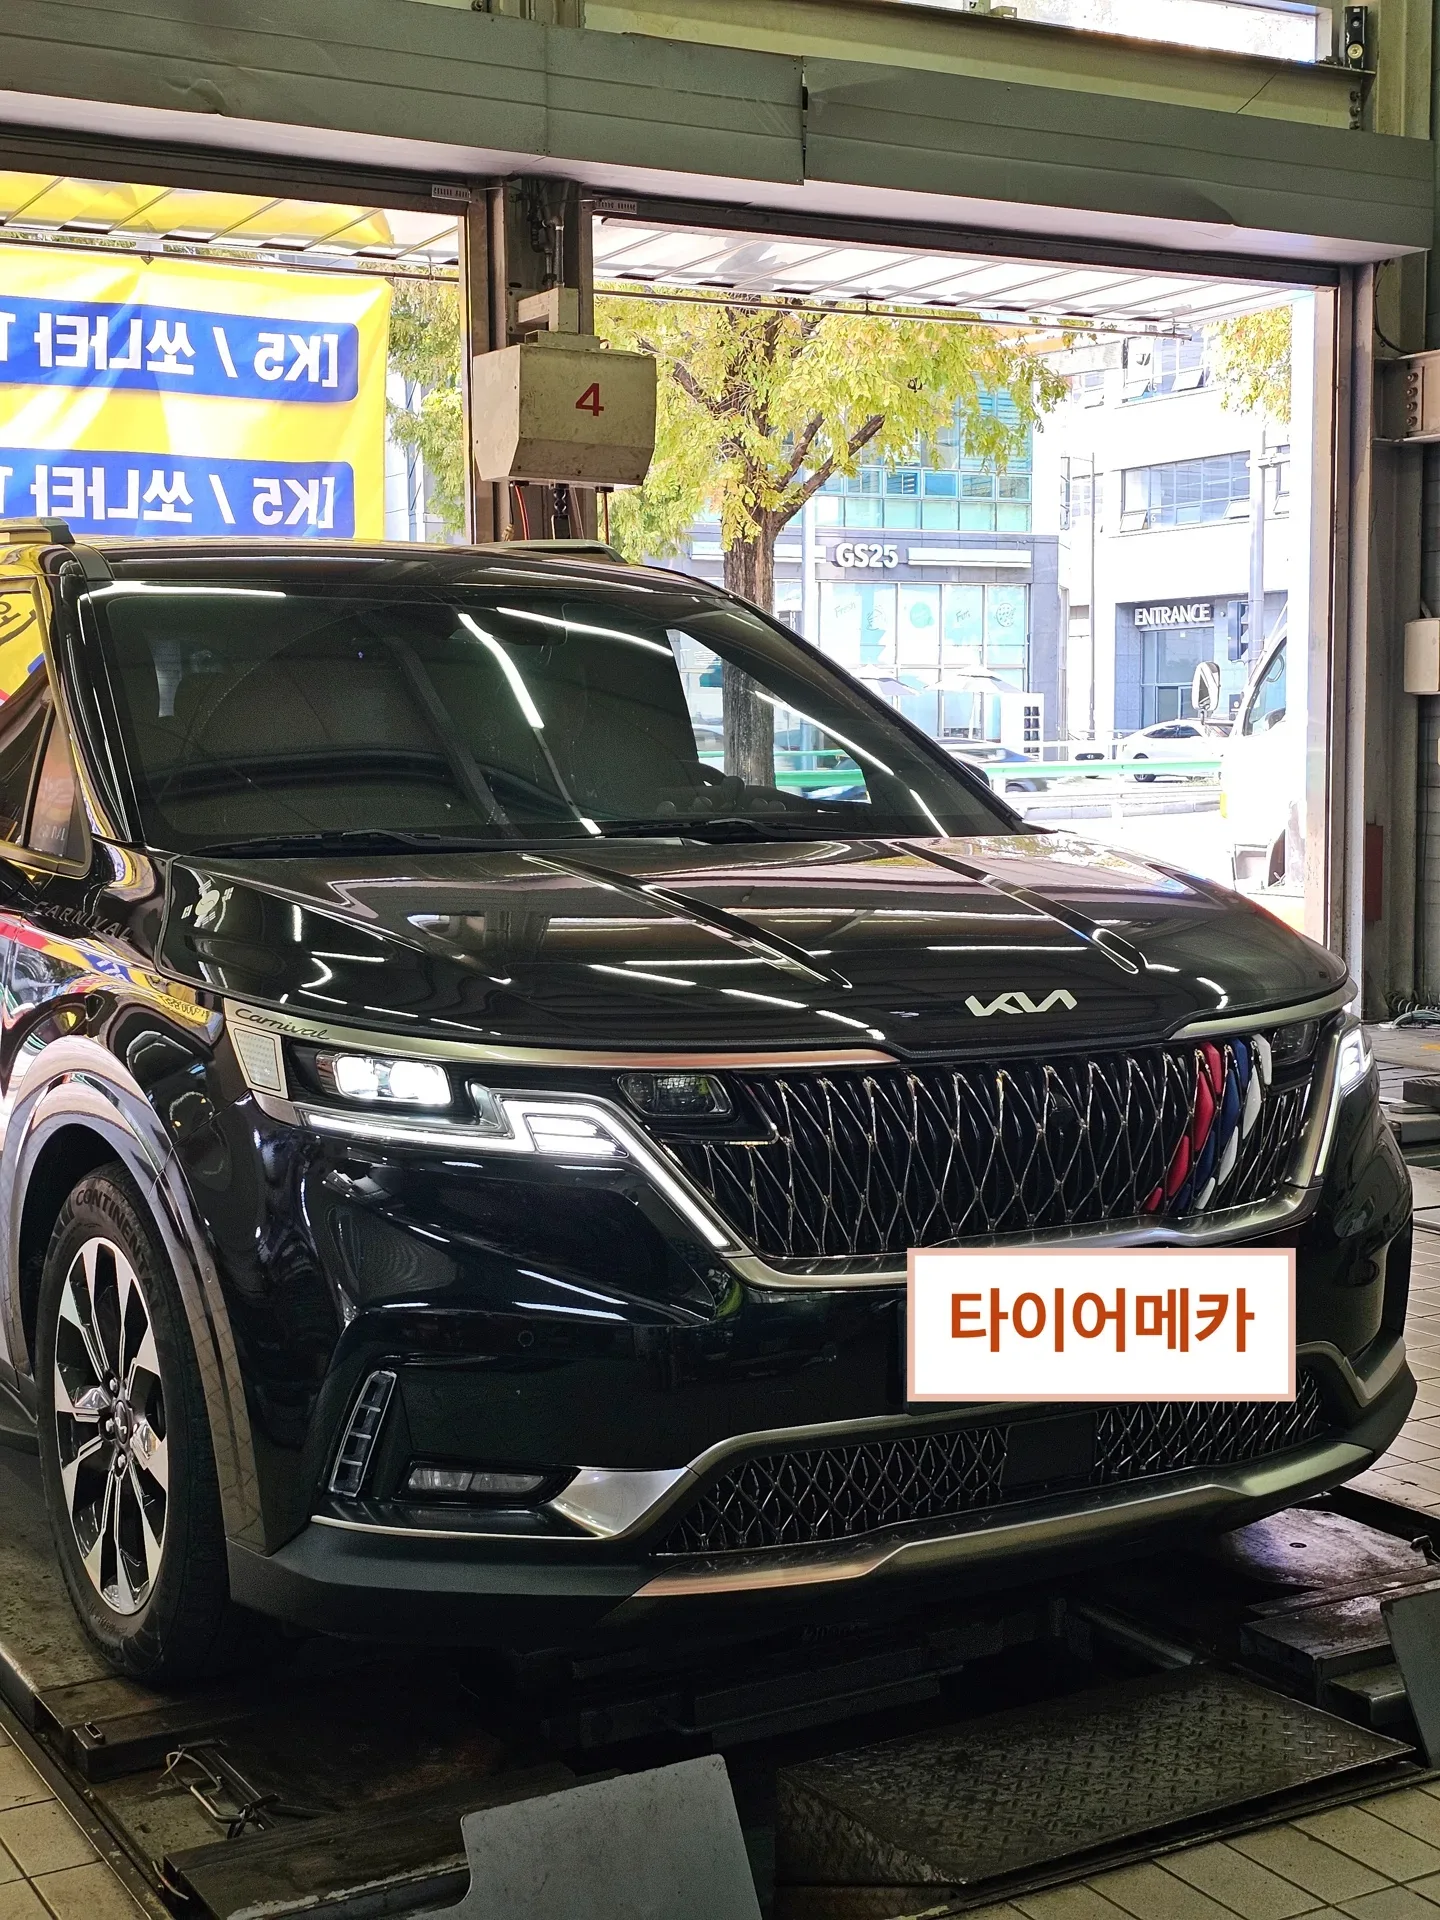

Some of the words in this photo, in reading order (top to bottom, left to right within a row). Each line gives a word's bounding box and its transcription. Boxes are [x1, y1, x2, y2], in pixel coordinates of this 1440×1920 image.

[575, 382, 605, 417] 4
[836, 542, 899, 569] GS25
[1134, 603, 1211, 626] ENTRANCE
[34, 900, 131, 941] CARNIVAL
[964, 989, 1078, 1017] KIA
[235, 1007, 330, 1041] Carnival
